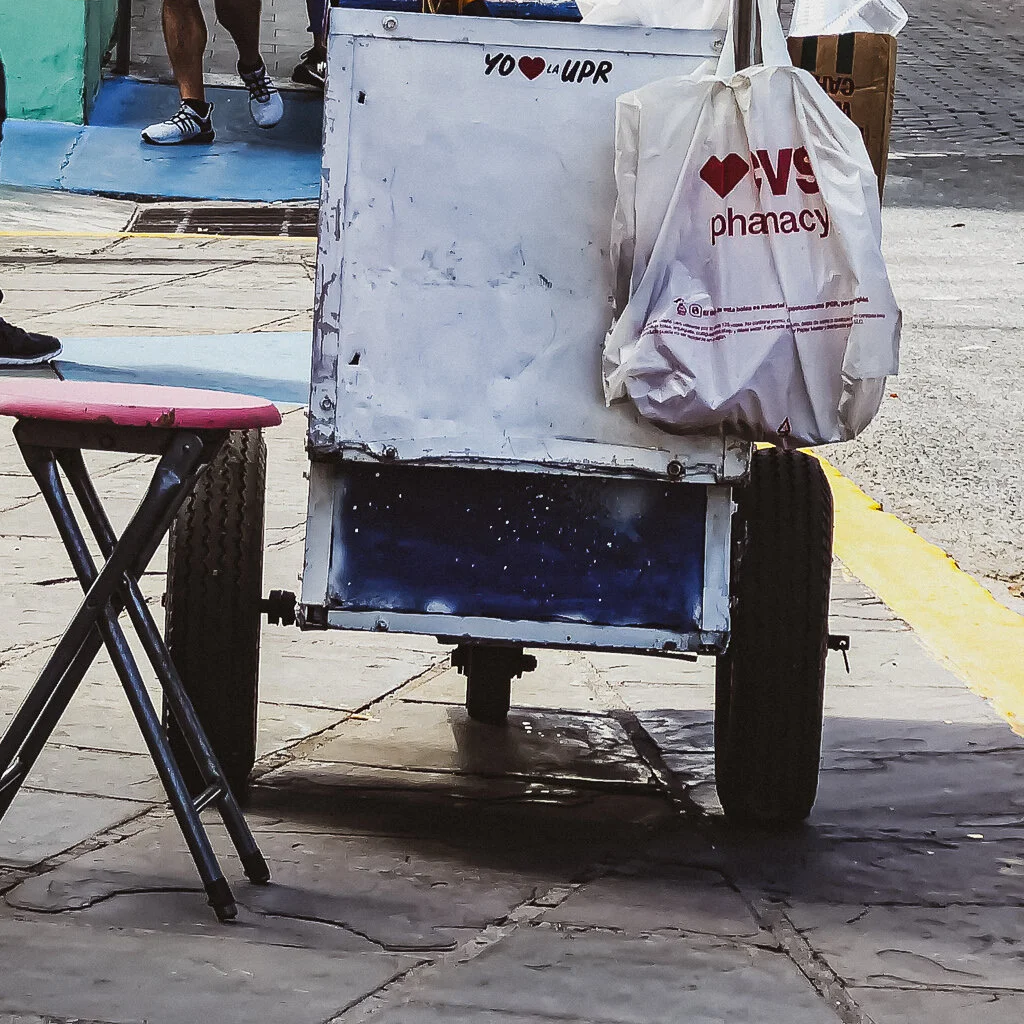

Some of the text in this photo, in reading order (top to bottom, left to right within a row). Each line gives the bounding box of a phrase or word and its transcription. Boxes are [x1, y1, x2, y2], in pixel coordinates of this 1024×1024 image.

[485, 53, 613, 84] YO LA UPR
[711, 207, 829, 245] phaacy
